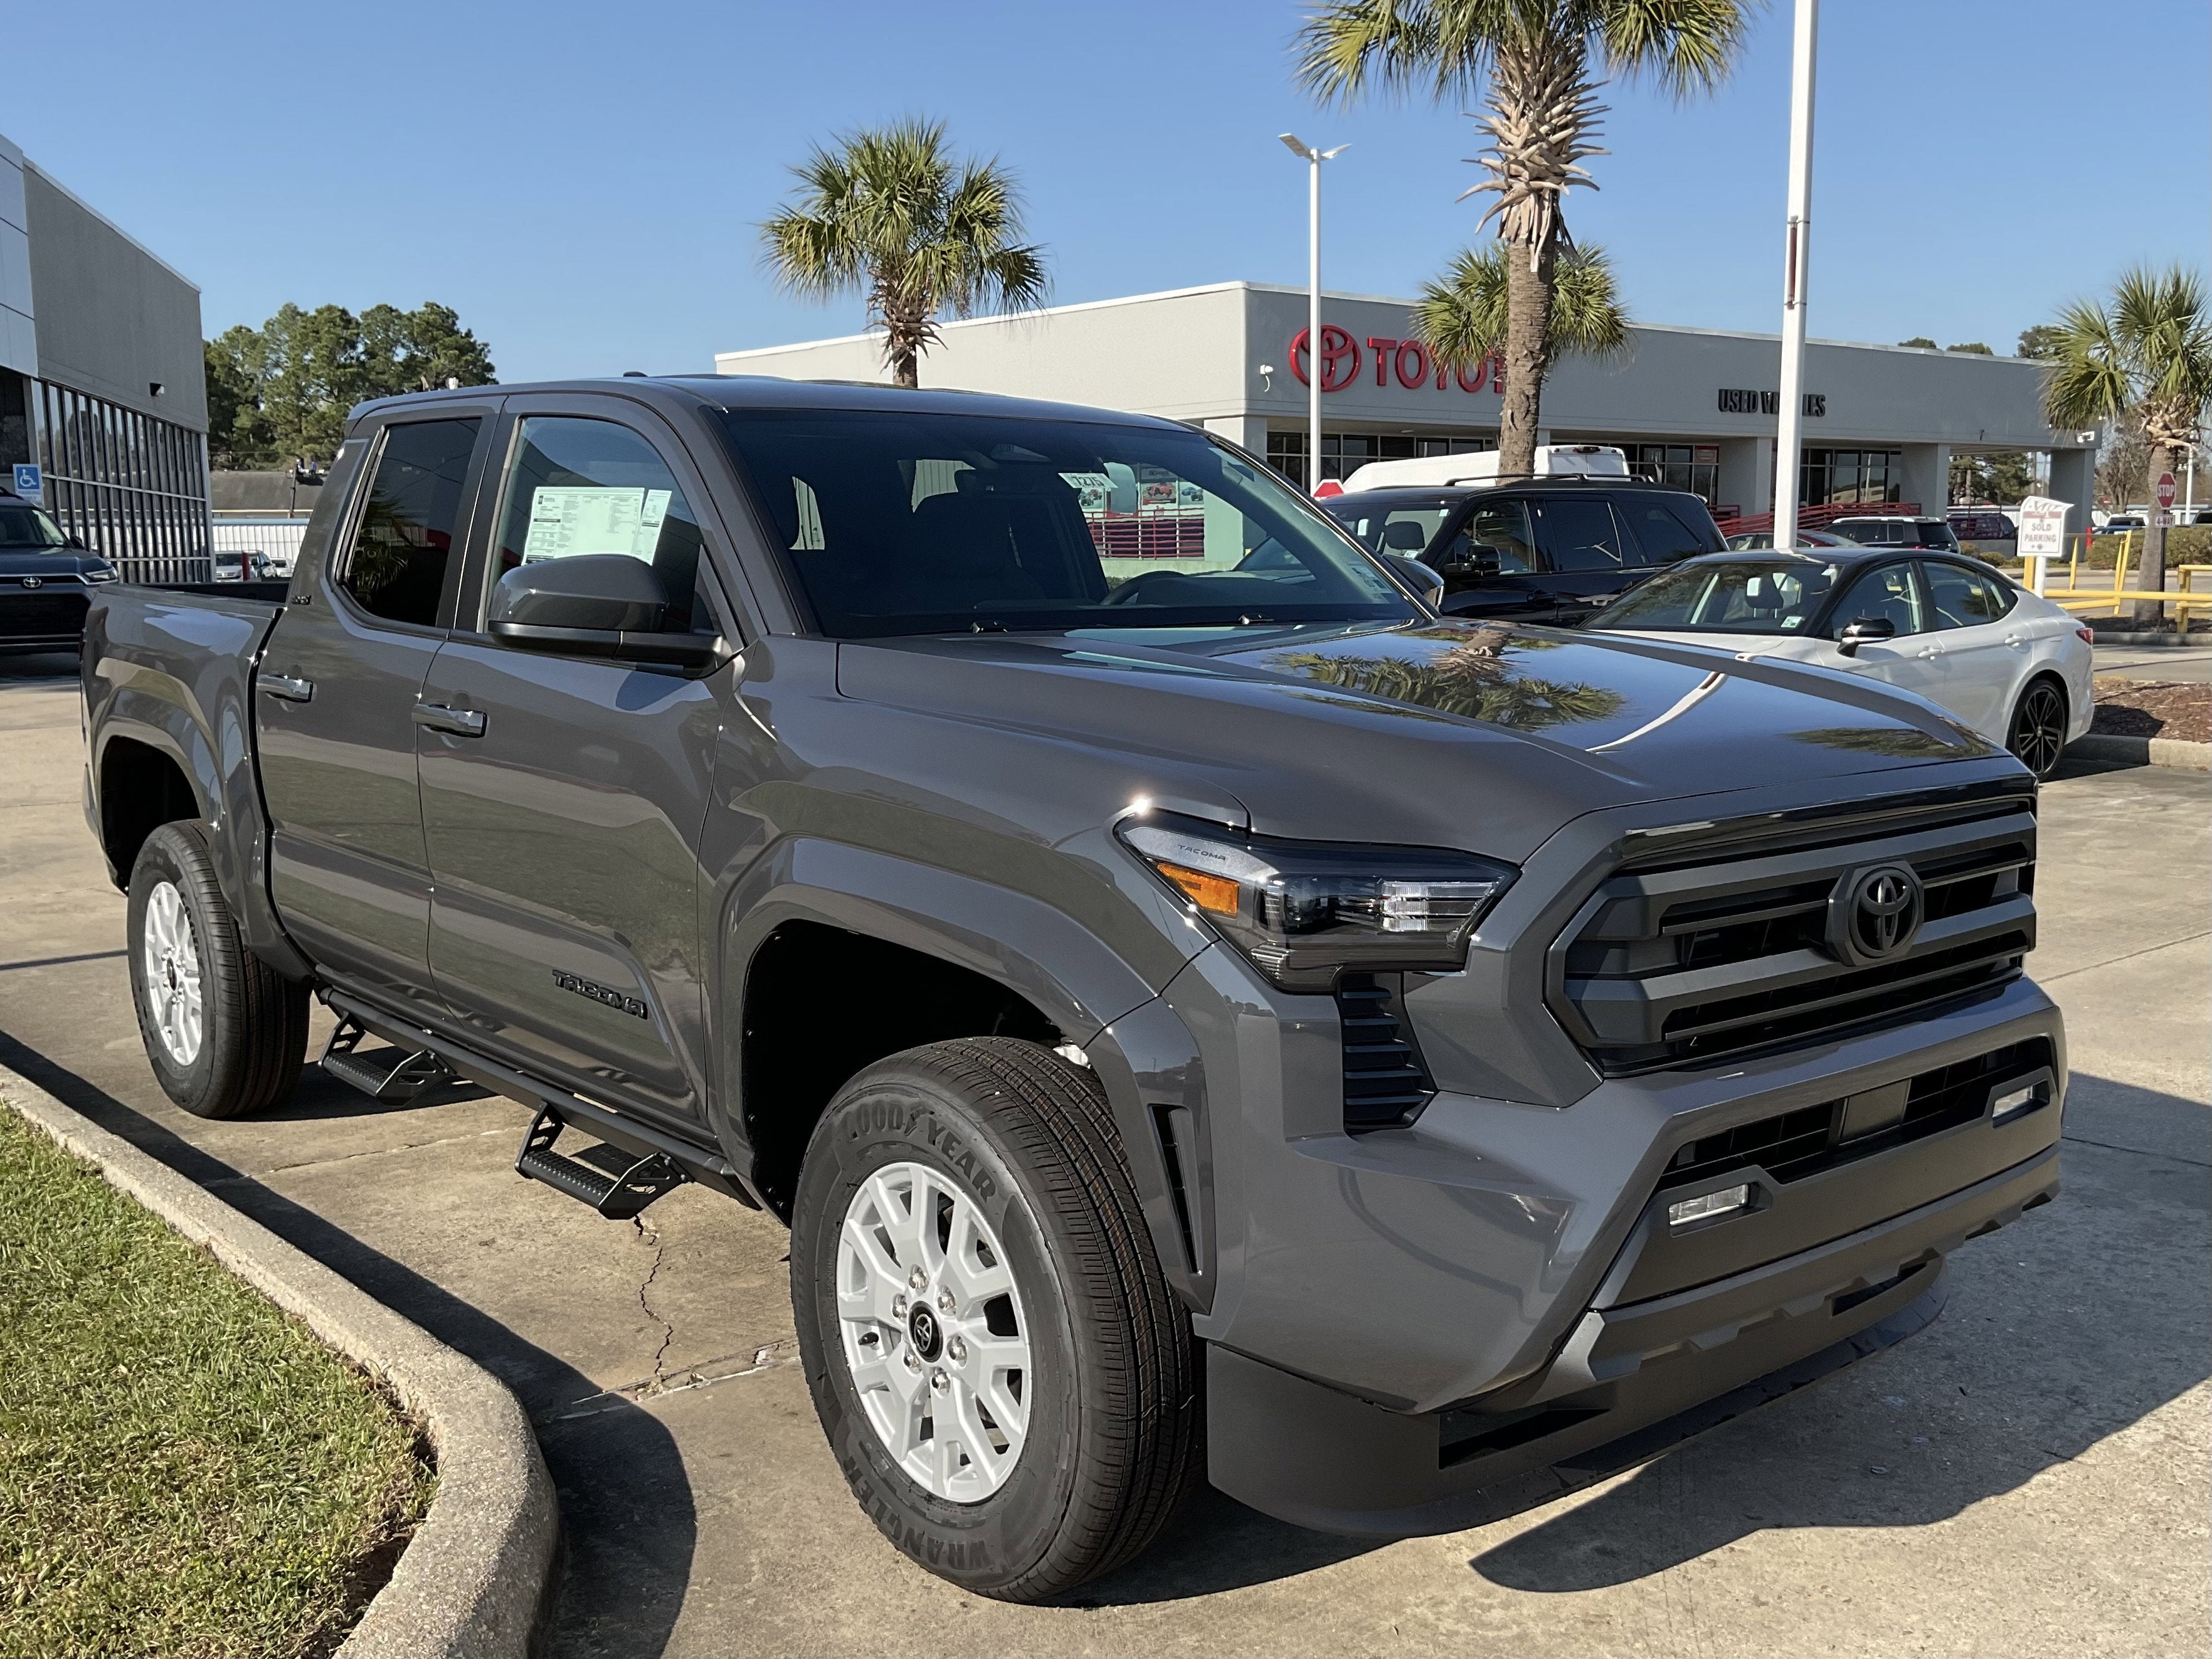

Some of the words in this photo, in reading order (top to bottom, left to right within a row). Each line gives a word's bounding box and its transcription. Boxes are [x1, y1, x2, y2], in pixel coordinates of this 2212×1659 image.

[1367, 337, 1506, 393] TOYOT
[1718, 389, 1759, 413] USED
[1760, 391, 1826, 416] VELES
[2157, 484, 2174, 497] STOP
[2031, 523, 2051, 531] SOLD
[2156, 516, 2174, 526] 4-WAY
[2024, 534, 2056, 543] PARKING
[1178, 844, 1226, 861] TACOMA
[552, 969, 648, 1020] TACOMA
